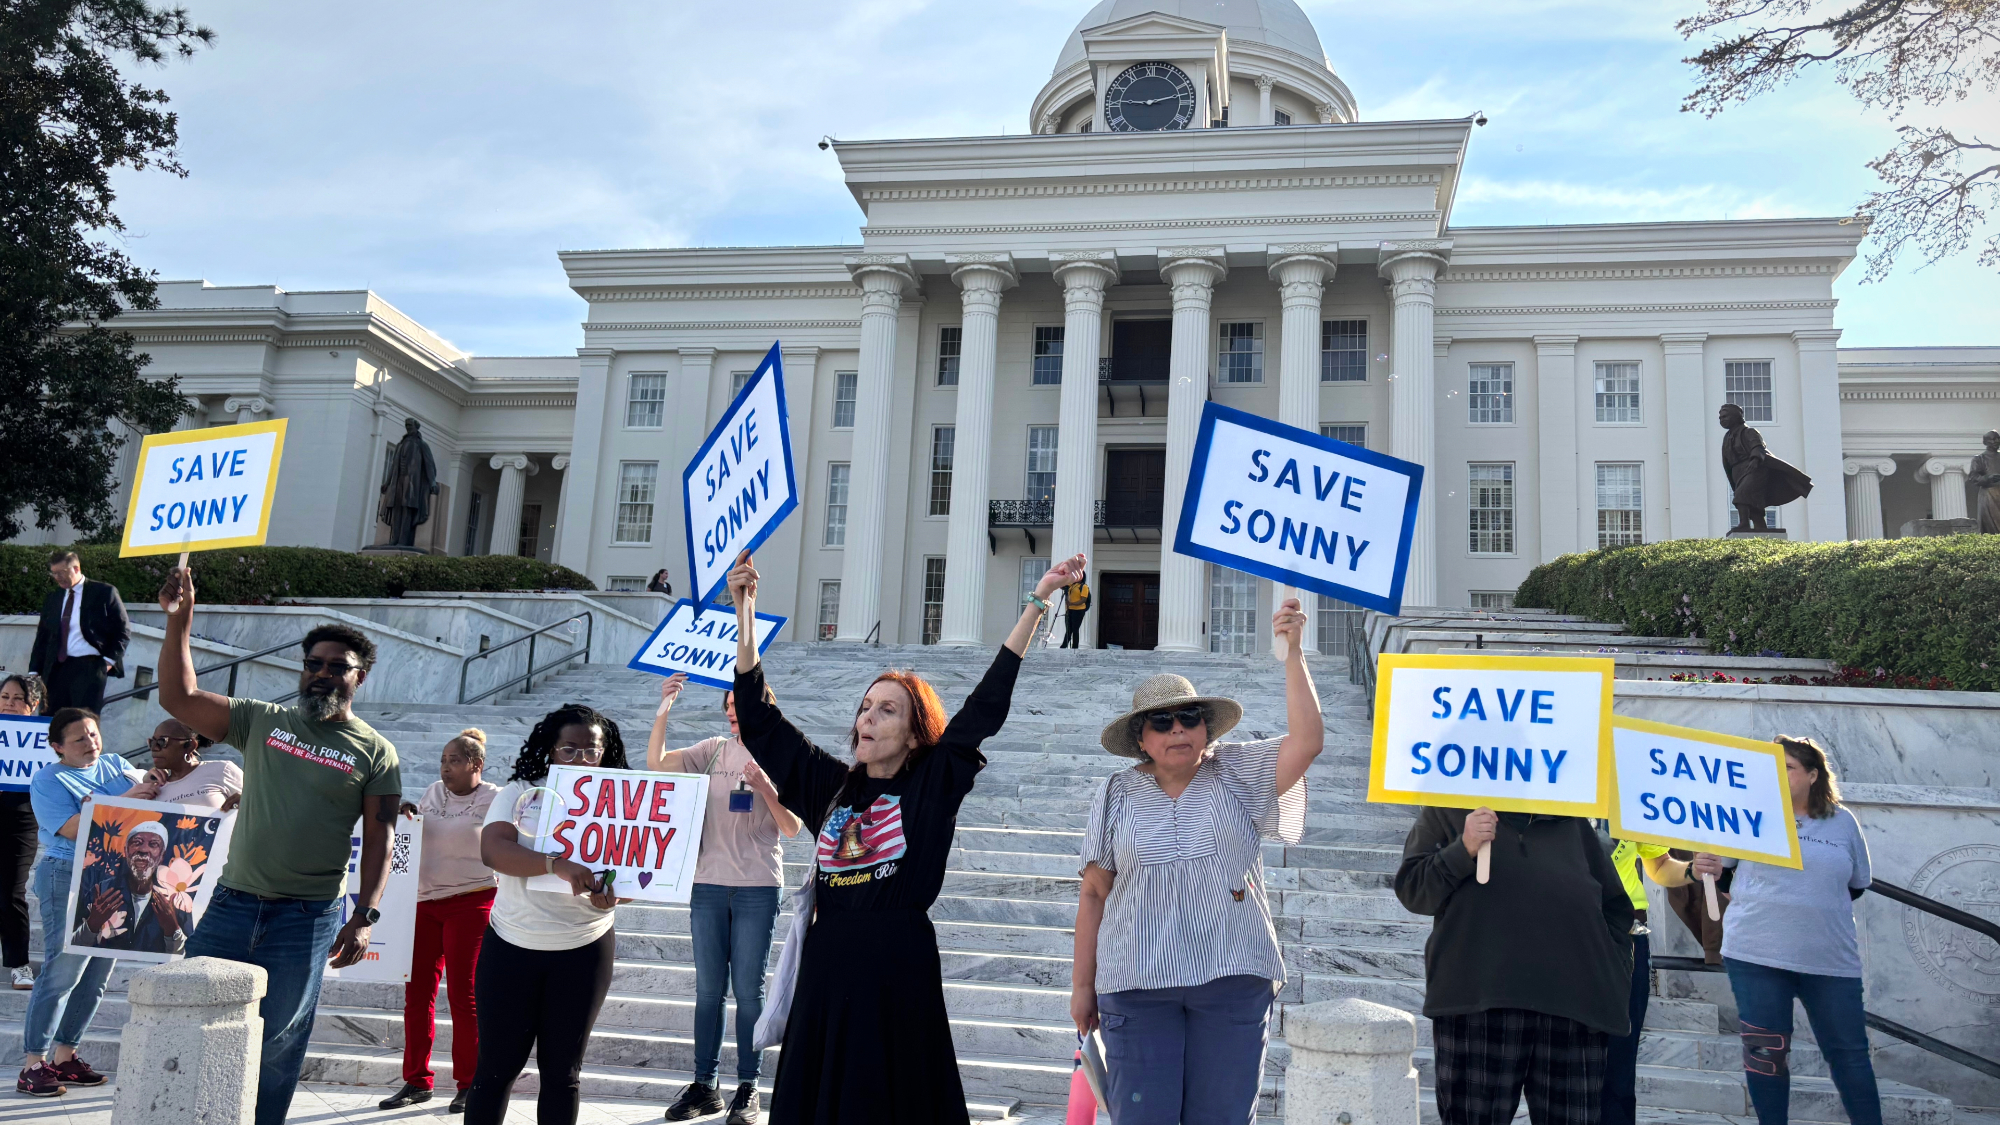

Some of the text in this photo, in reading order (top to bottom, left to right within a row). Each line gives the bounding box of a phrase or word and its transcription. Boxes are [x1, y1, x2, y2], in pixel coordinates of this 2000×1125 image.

[169, 449, 248, 484] SAVE
[706, 407, 759, 502] SAVE
[1248, 449, 1367, 513] SAVE
[150, 494, 248, 532] SONNY
[704, 459, 770, 568] SONNY
[1220, 499, 1371, 572] SONNY
[657, 641, 737, 671] SONNY
[1432, 686, 1555, 724] SAVE
[0, 730, 48, 749] AVE
[270, 727, 297, 745] DON'T
[319, 746, 340, 760] FOR
[341, 754, 357, 766] ME
[270, 740, 295, 752] OPPOSE
[294, 748, 305, 757] THE
[305, 752, 324, 763] DEATH
[324, 758, 352, 772] PENALTY
[1411, 741, 1568, 784] SONNY
[1650, 748, 1747, 789] SAVE
[568, 775, 675, 823] SAVE
[1640, 792, 1763, 838] SONNY
[552, 819, 677, 870] SONNY
[829, 871, 872, 887] Freedom
[1913, 847, 1979, 892] ANCE SPAIN
[1905, 921, 1955, 992] CONFEDERATE
